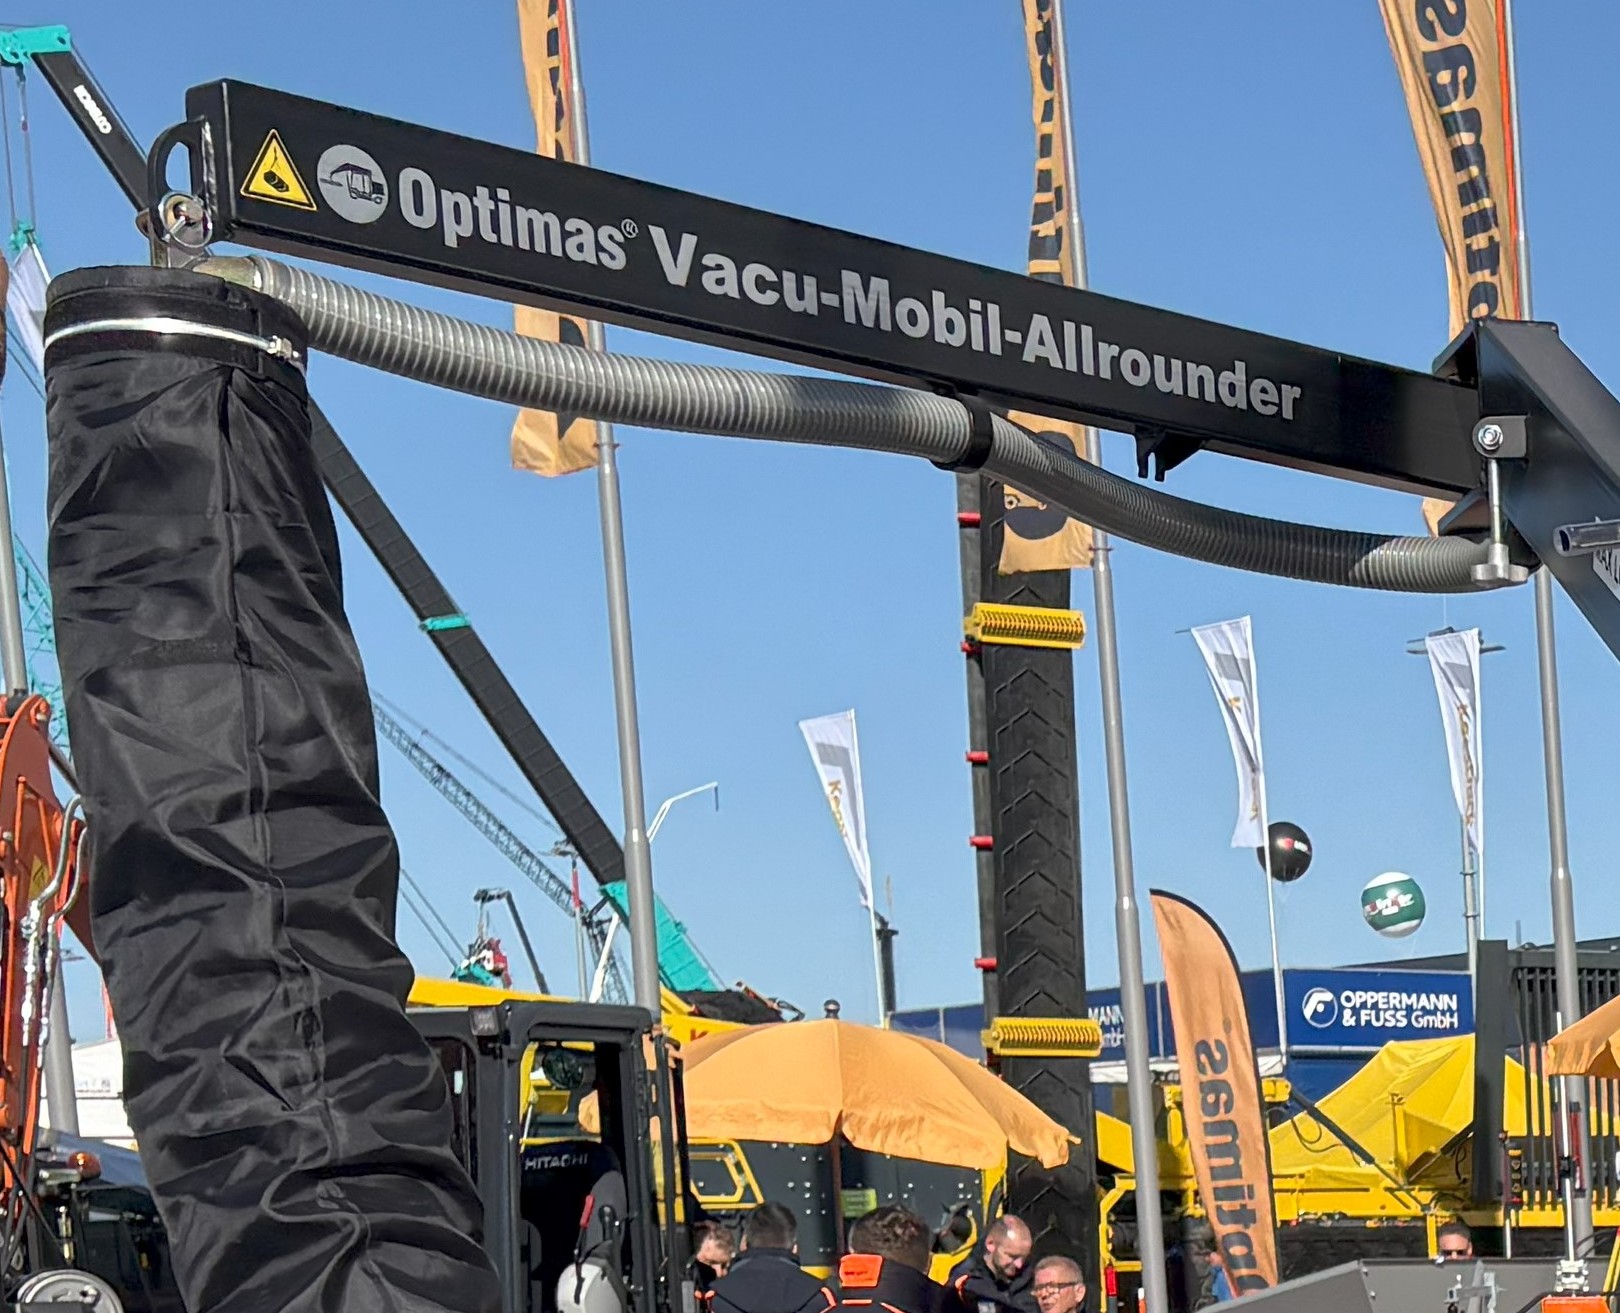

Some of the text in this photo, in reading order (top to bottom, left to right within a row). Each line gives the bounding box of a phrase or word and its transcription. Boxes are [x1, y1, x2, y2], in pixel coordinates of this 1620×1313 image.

[648, 224, 1302, 421] Vacu-Mobil-Allrounder
[1340, 990, 1458, 1011] OPPERMANN
[1342, 1008, 1458, 1029] & FUSS GmbH
[524, 1153, 589, 1170] HITACHI
